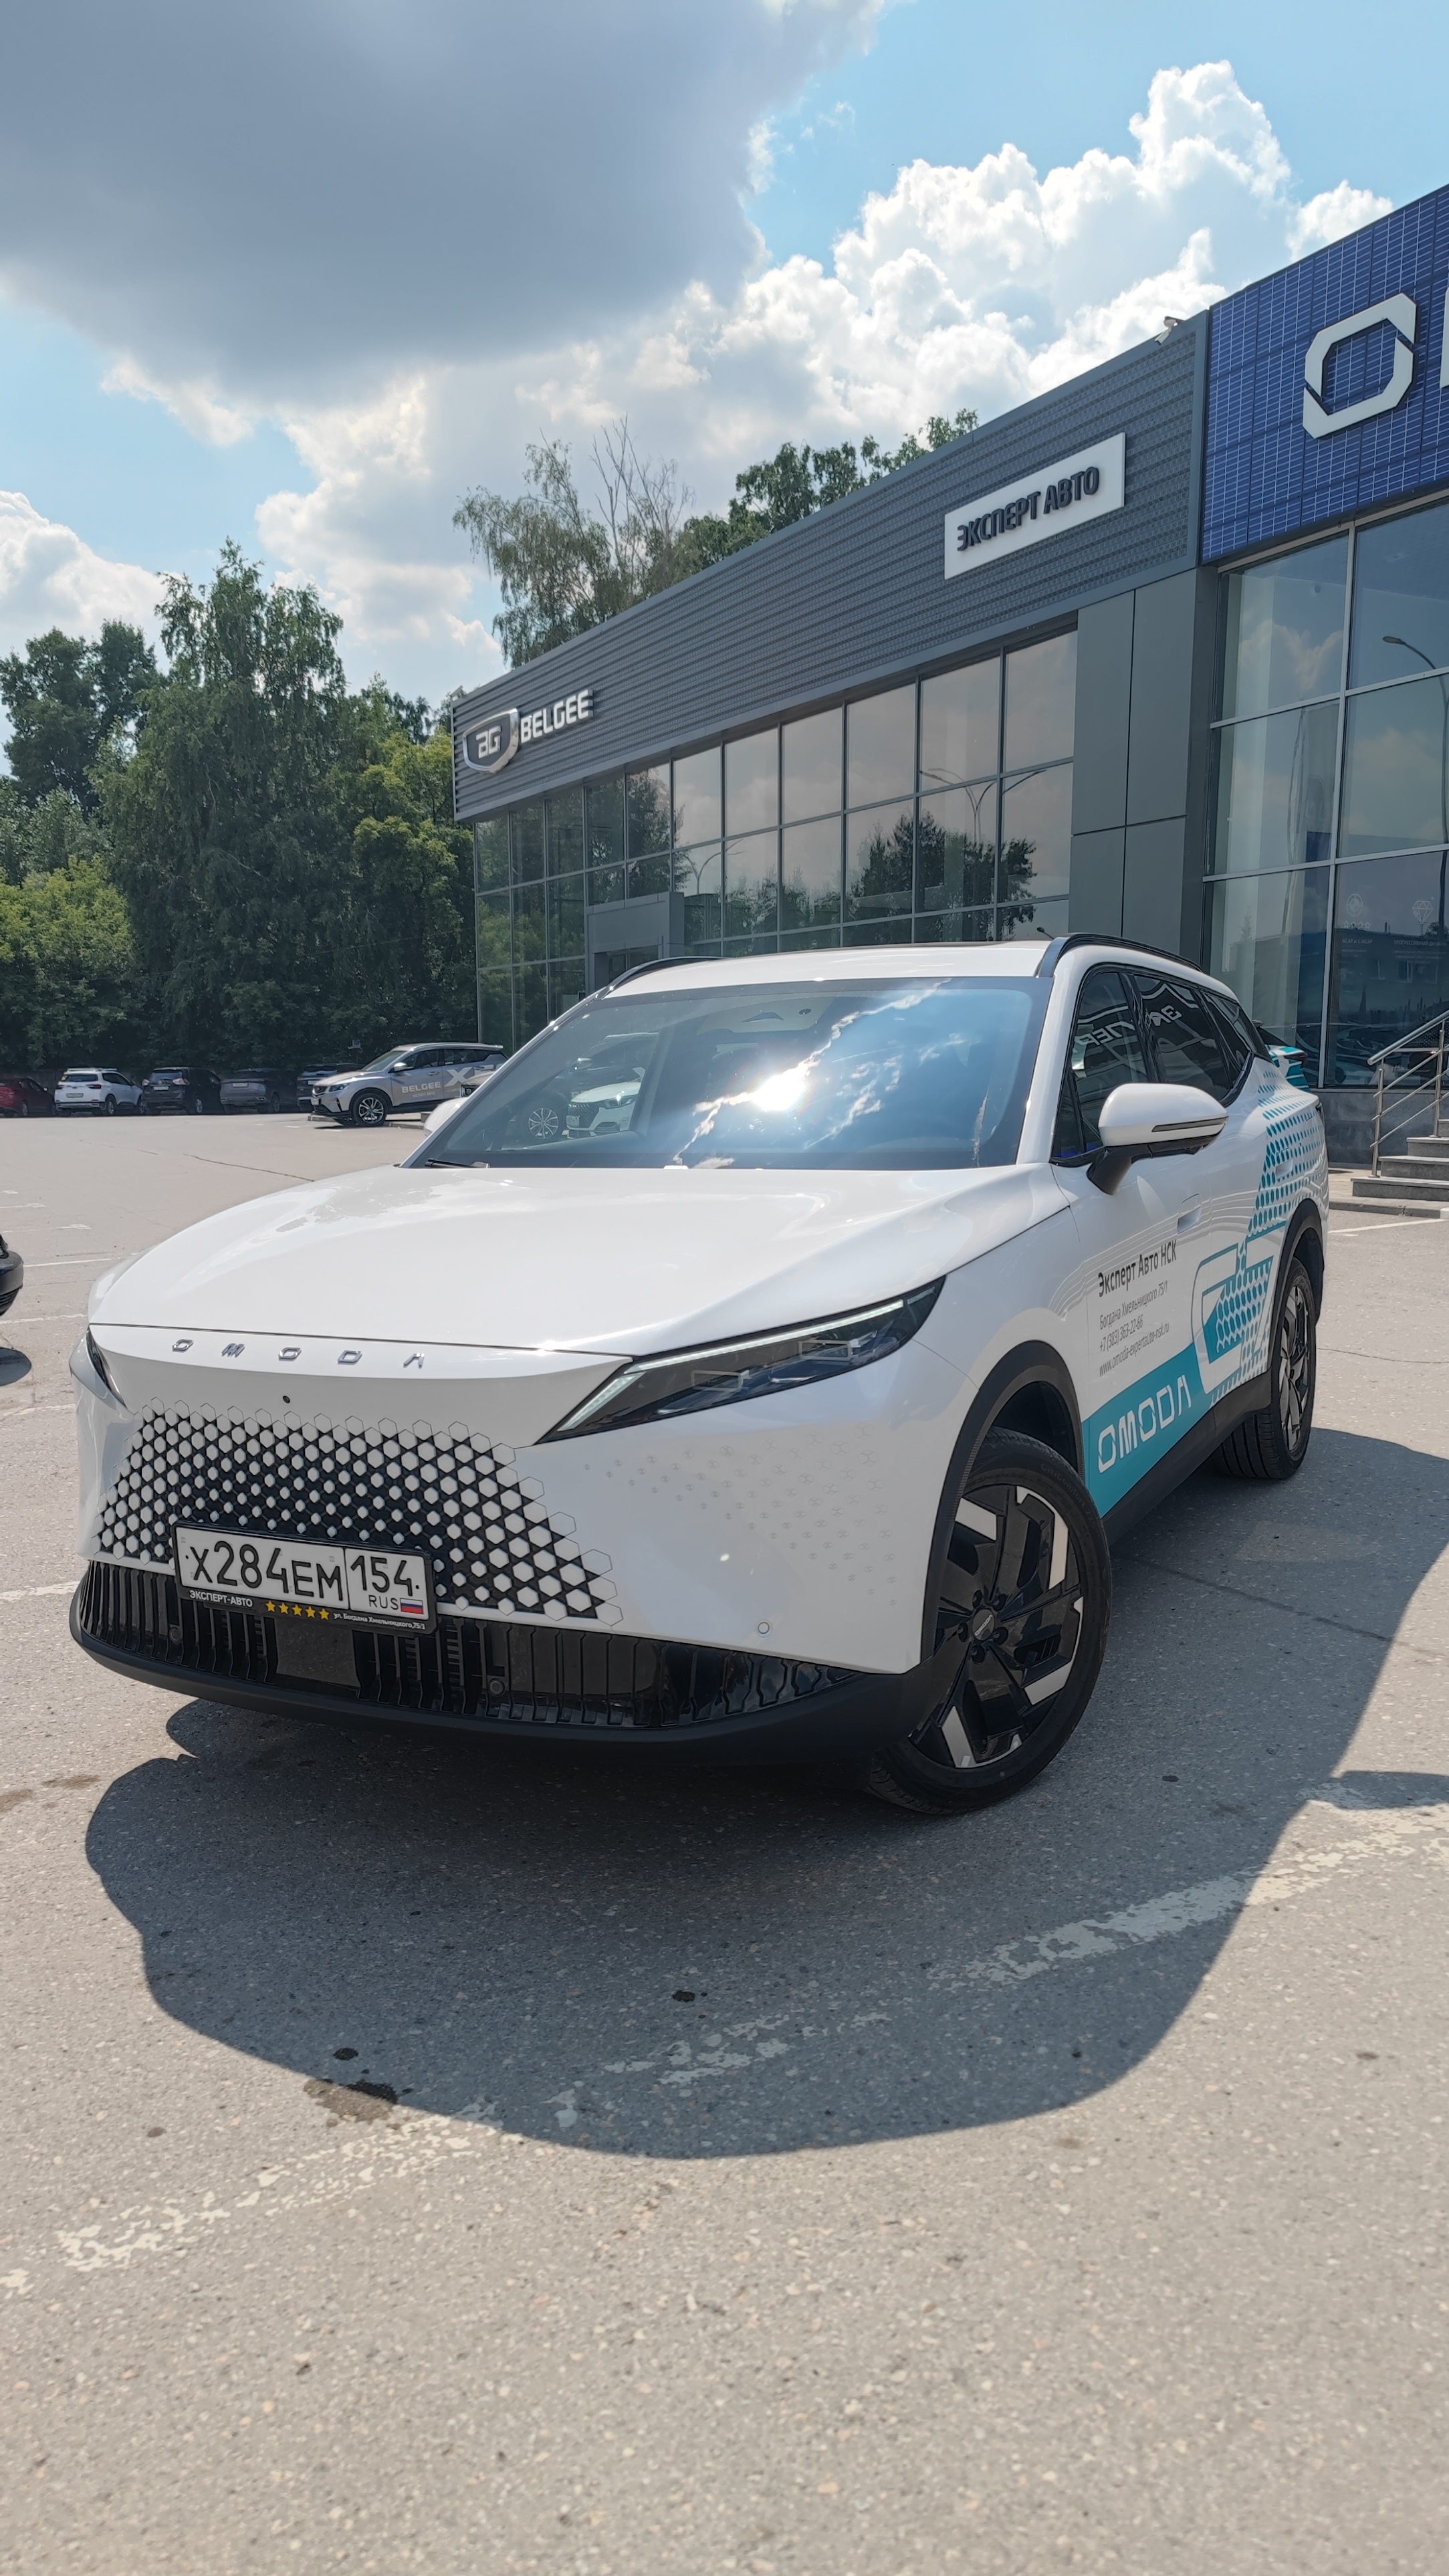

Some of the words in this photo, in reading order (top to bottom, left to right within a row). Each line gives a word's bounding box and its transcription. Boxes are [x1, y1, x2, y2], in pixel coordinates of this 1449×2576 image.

[1303, 285, 1449, 439] O
[957, 490, 1042, 552] ЭКСПЕРТ
[1043, 465, 1100, 514] АВТО
[520, 689, 593, 744] BELGEE
[401, 1081, 441, 1093] BELGEE
[1098, 1261, 1136, 1297] Эксперт
[1137, 1253, 1159, 1279] Авто
[1160, 1239, 1177, 1267] НСК
[1100, 1308, 1121, 1330] Богдана
[1121, 1289, 1157, 1317] Хмельницкого
[1158, 1280, 1168, 1297] 75/1
[172, 1338, 425, 1368] OMODA
[1099, 1321, 1170, 1378] www.omoda-expertauto-nsk.ru
[1100, 1336, 1107, 1352] +7
[1107, 1329, 1119, 1352] (383)
[1119, 1314, 1143, 1341] 363-22-66
[1097, 1374, 1192, 1473] OMODA
[189, 1540, 344, 1602] Х284ЕМ
[350, 1554, 413, 1597] 154
[189, 1590, 253, 1608] ЭКСПЕРТ-АВТО
[334, 1612, 343, 1620] ул.
[343, 1612, 368, 1623] Богдана
[368, 1594, 399, 1611] RUS
